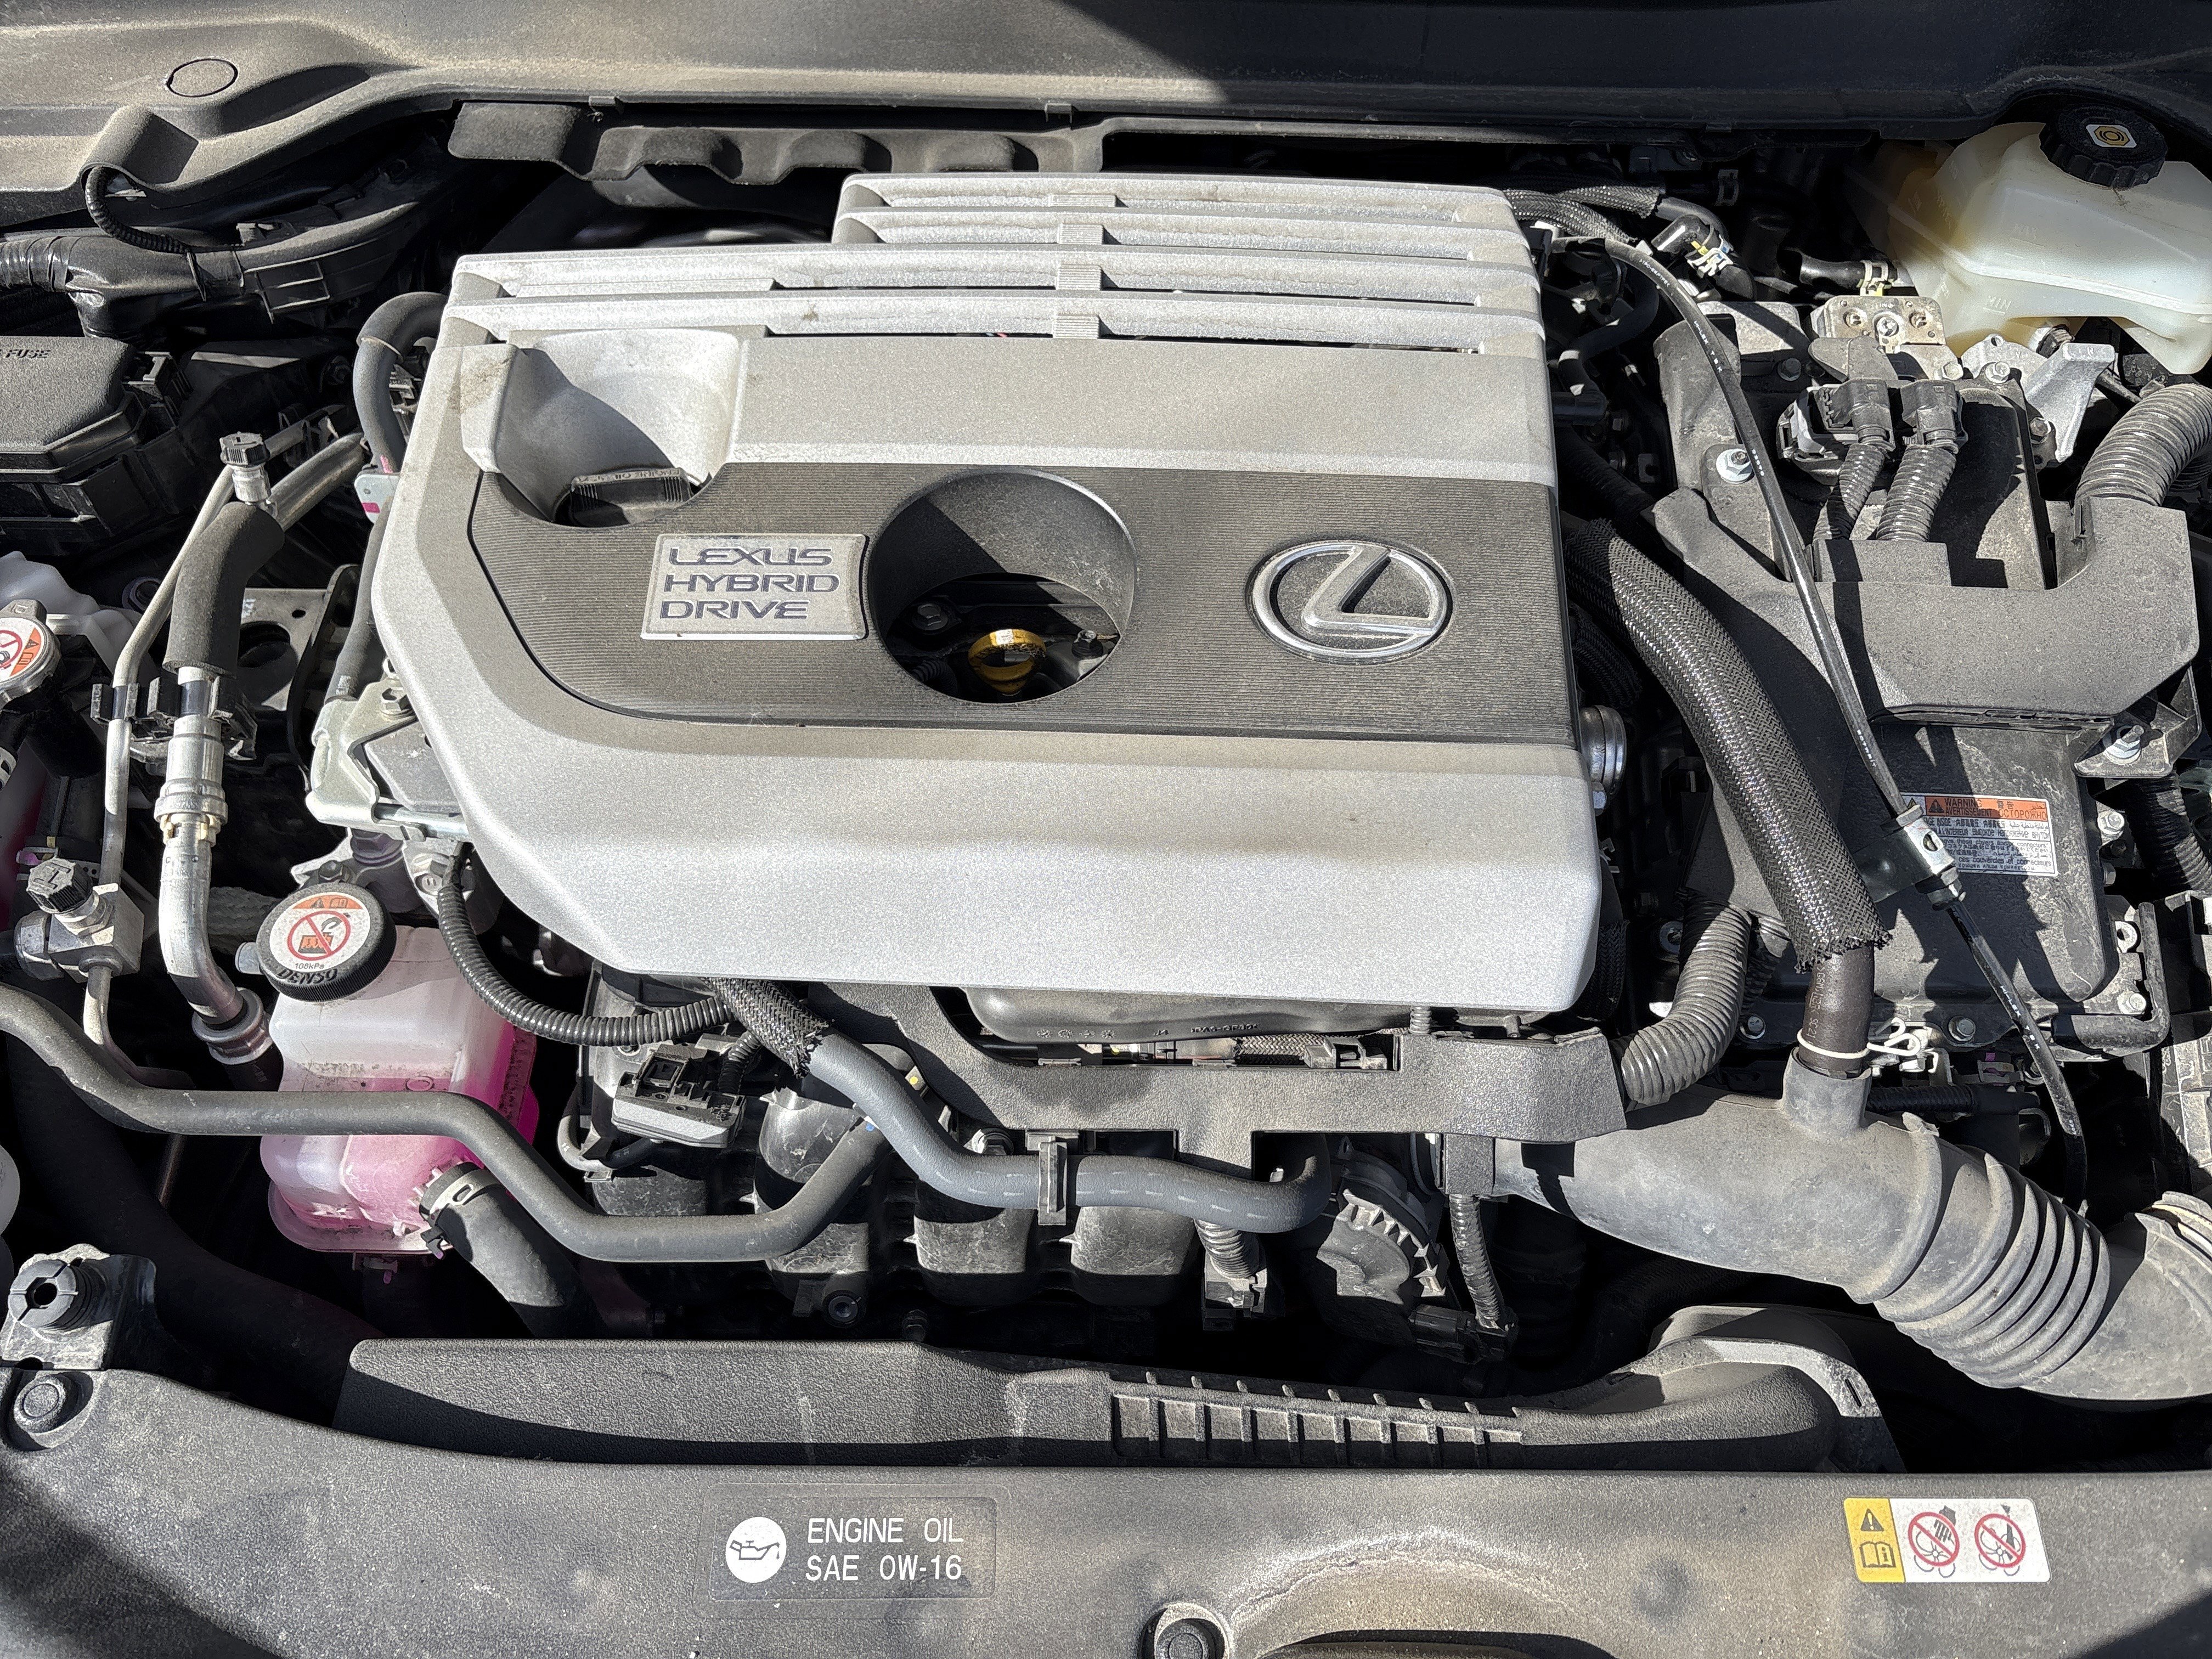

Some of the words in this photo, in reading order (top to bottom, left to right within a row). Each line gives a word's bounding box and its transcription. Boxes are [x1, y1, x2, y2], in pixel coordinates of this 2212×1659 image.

[1988, 295, 2012, 311] MIN
[5, 349, 51, 359] FUSE
[669, 546, 833, 566] LEXUS
[664, 573, 842, 592] HYBRID
[660, 600, 810, 619] DRIVE
[1944, 797, 1982, 808] WARNING
[1945, 807, 1993, 817] AVERTISSEMENT
[1999, 809, 2047, 821] ОСТОРОЖНО
[276, 967, 338, 985] DENSO
[808, 1517, 904, 1543] ENGINE
[924, 1517, 964, 1543] OIL
[805, 1555, 860, 1581] SAE
[879, 1554, 962, 1581] 0W-16
